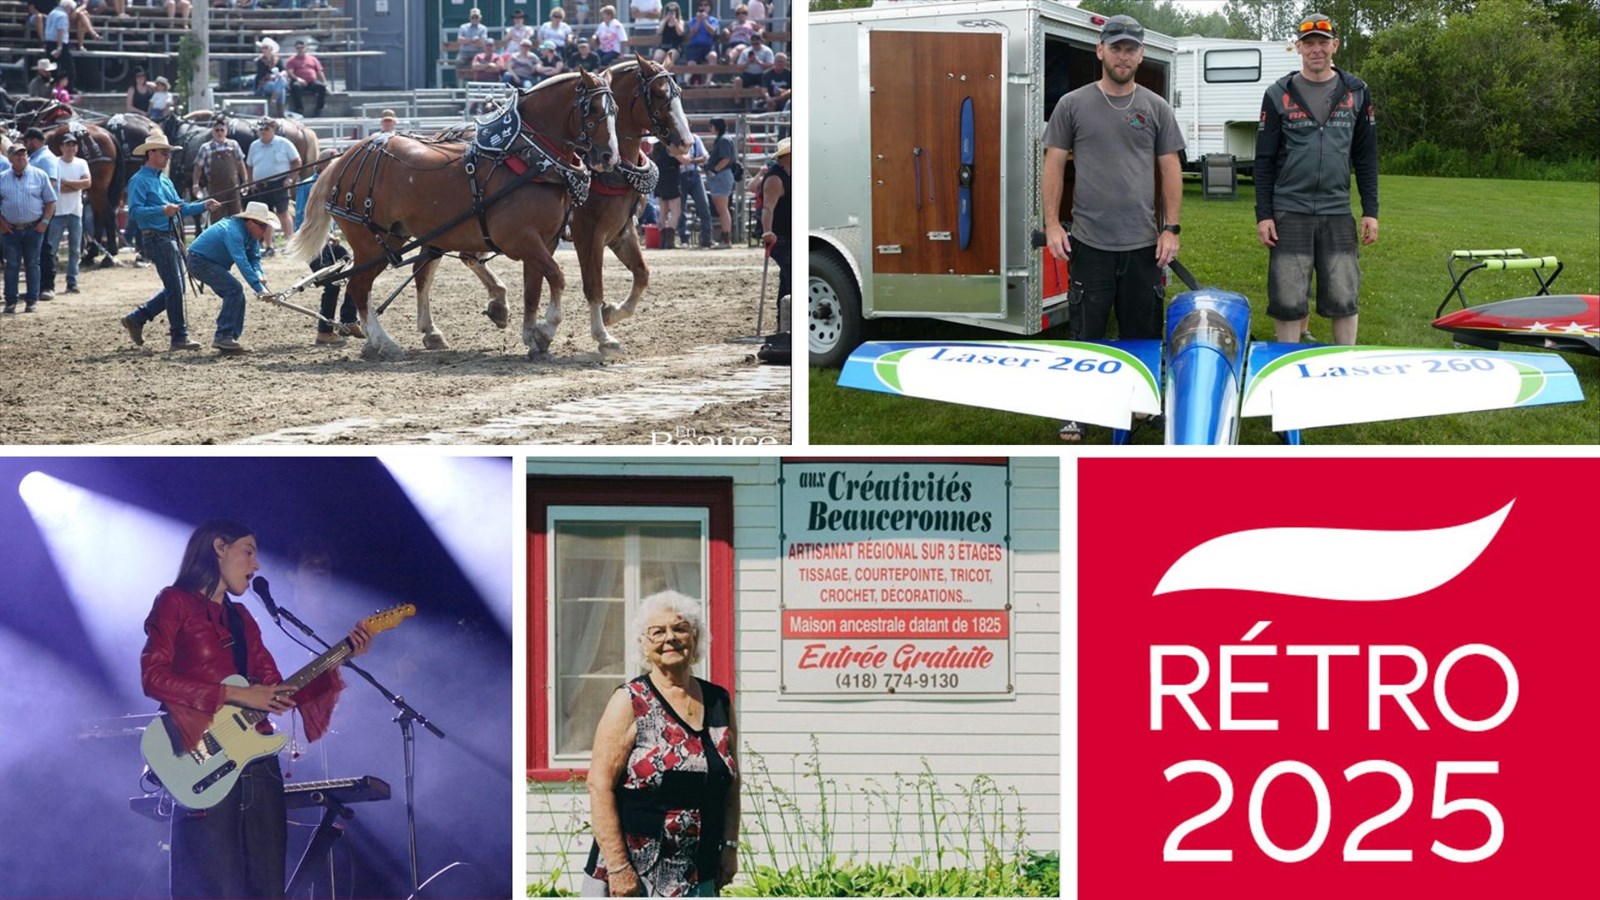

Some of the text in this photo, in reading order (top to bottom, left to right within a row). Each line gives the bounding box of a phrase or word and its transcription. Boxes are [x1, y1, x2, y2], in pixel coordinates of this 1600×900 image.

[930, 348, 1122, 374] Laser 260
[1296, 358, 1495, 378] Laser 260
[799, 470, 972, 502] aux Créativités
[806, 501, 993, 533] Beauceronnes
[788, 537, 1002, 561] ARTISANAT RÉGIONAL SUR 3 ÉTAGES
[799, 568, 993, 584] TISSAGE, COURTEPOINTE, TRICOT,
[820, 585, 973, 604] CROCHET, DÉCORATIONS...
[790, 616, 1001, 633] Maison ancestrale datant de 1825
[798, 643, 994, 671] Entrée Gratuite
[835, 673, 959, 689] (418) 774-9130
[1150, 620, 1520, 732] RÉTRO
[1163, 759, 1505, 864] 2025
